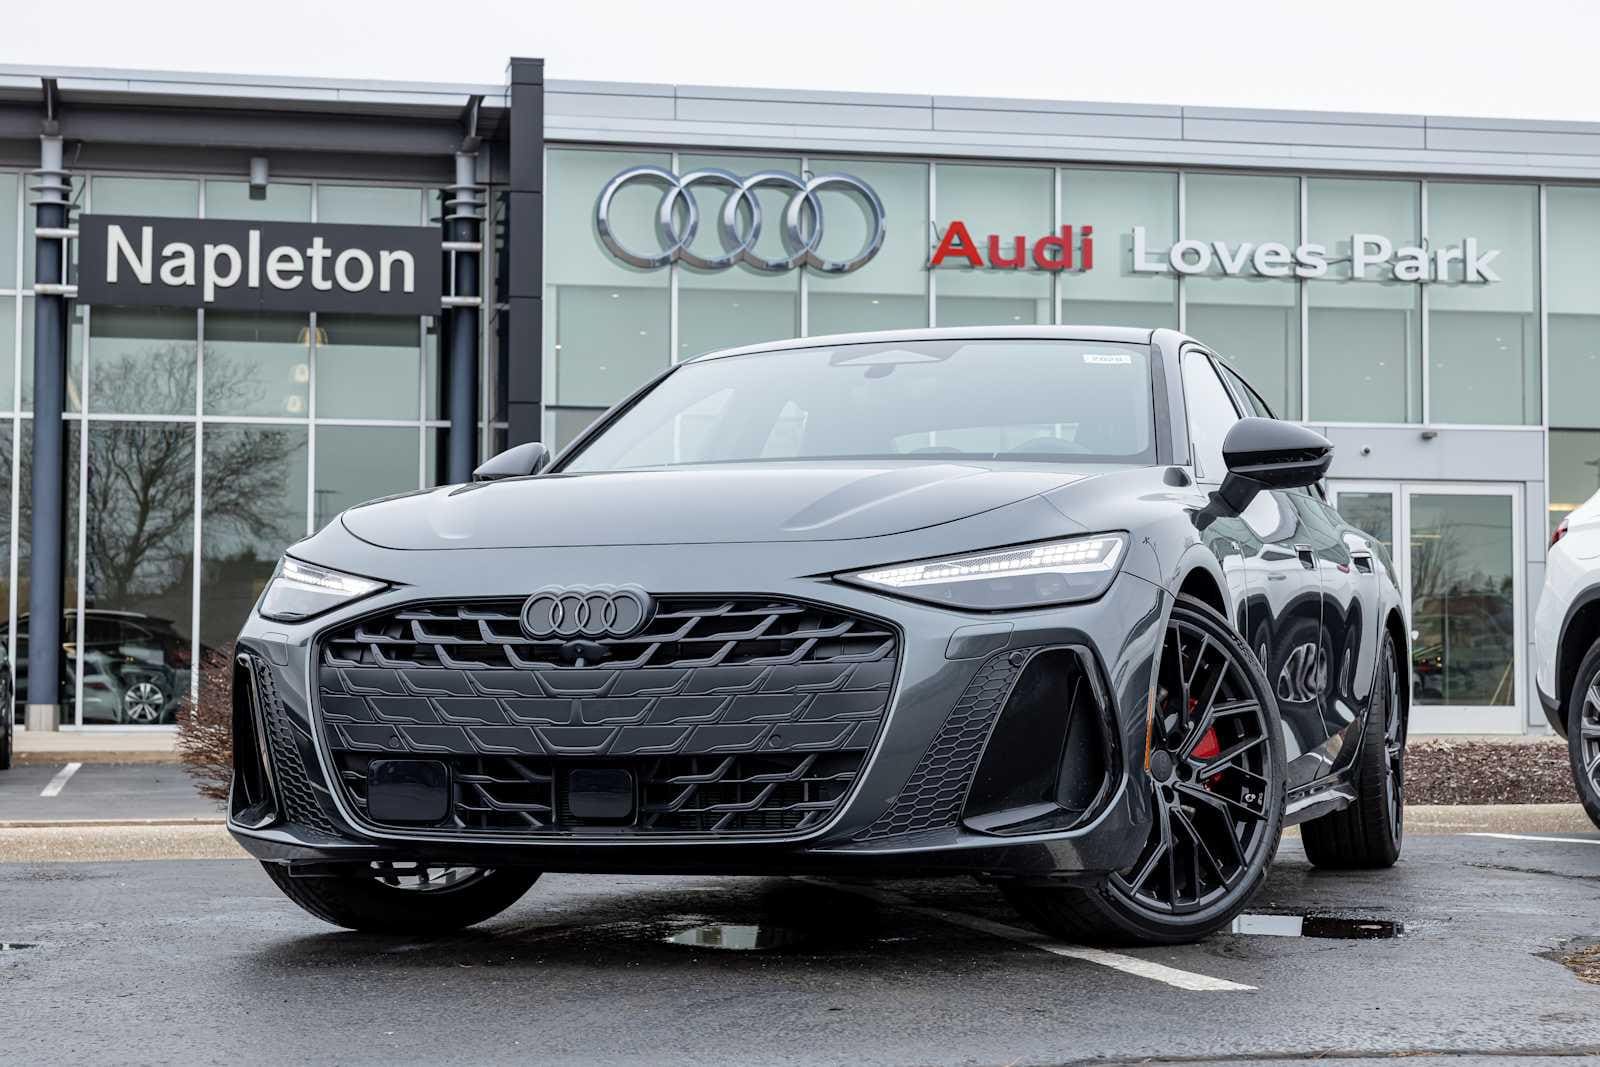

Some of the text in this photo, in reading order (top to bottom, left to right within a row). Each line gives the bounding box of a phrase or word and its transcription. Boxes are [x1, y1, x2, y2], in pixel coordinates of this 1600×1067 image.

[106, 225, 415, 302] Napleton
[930, 220, 1502, 283] Audi Loves Park
